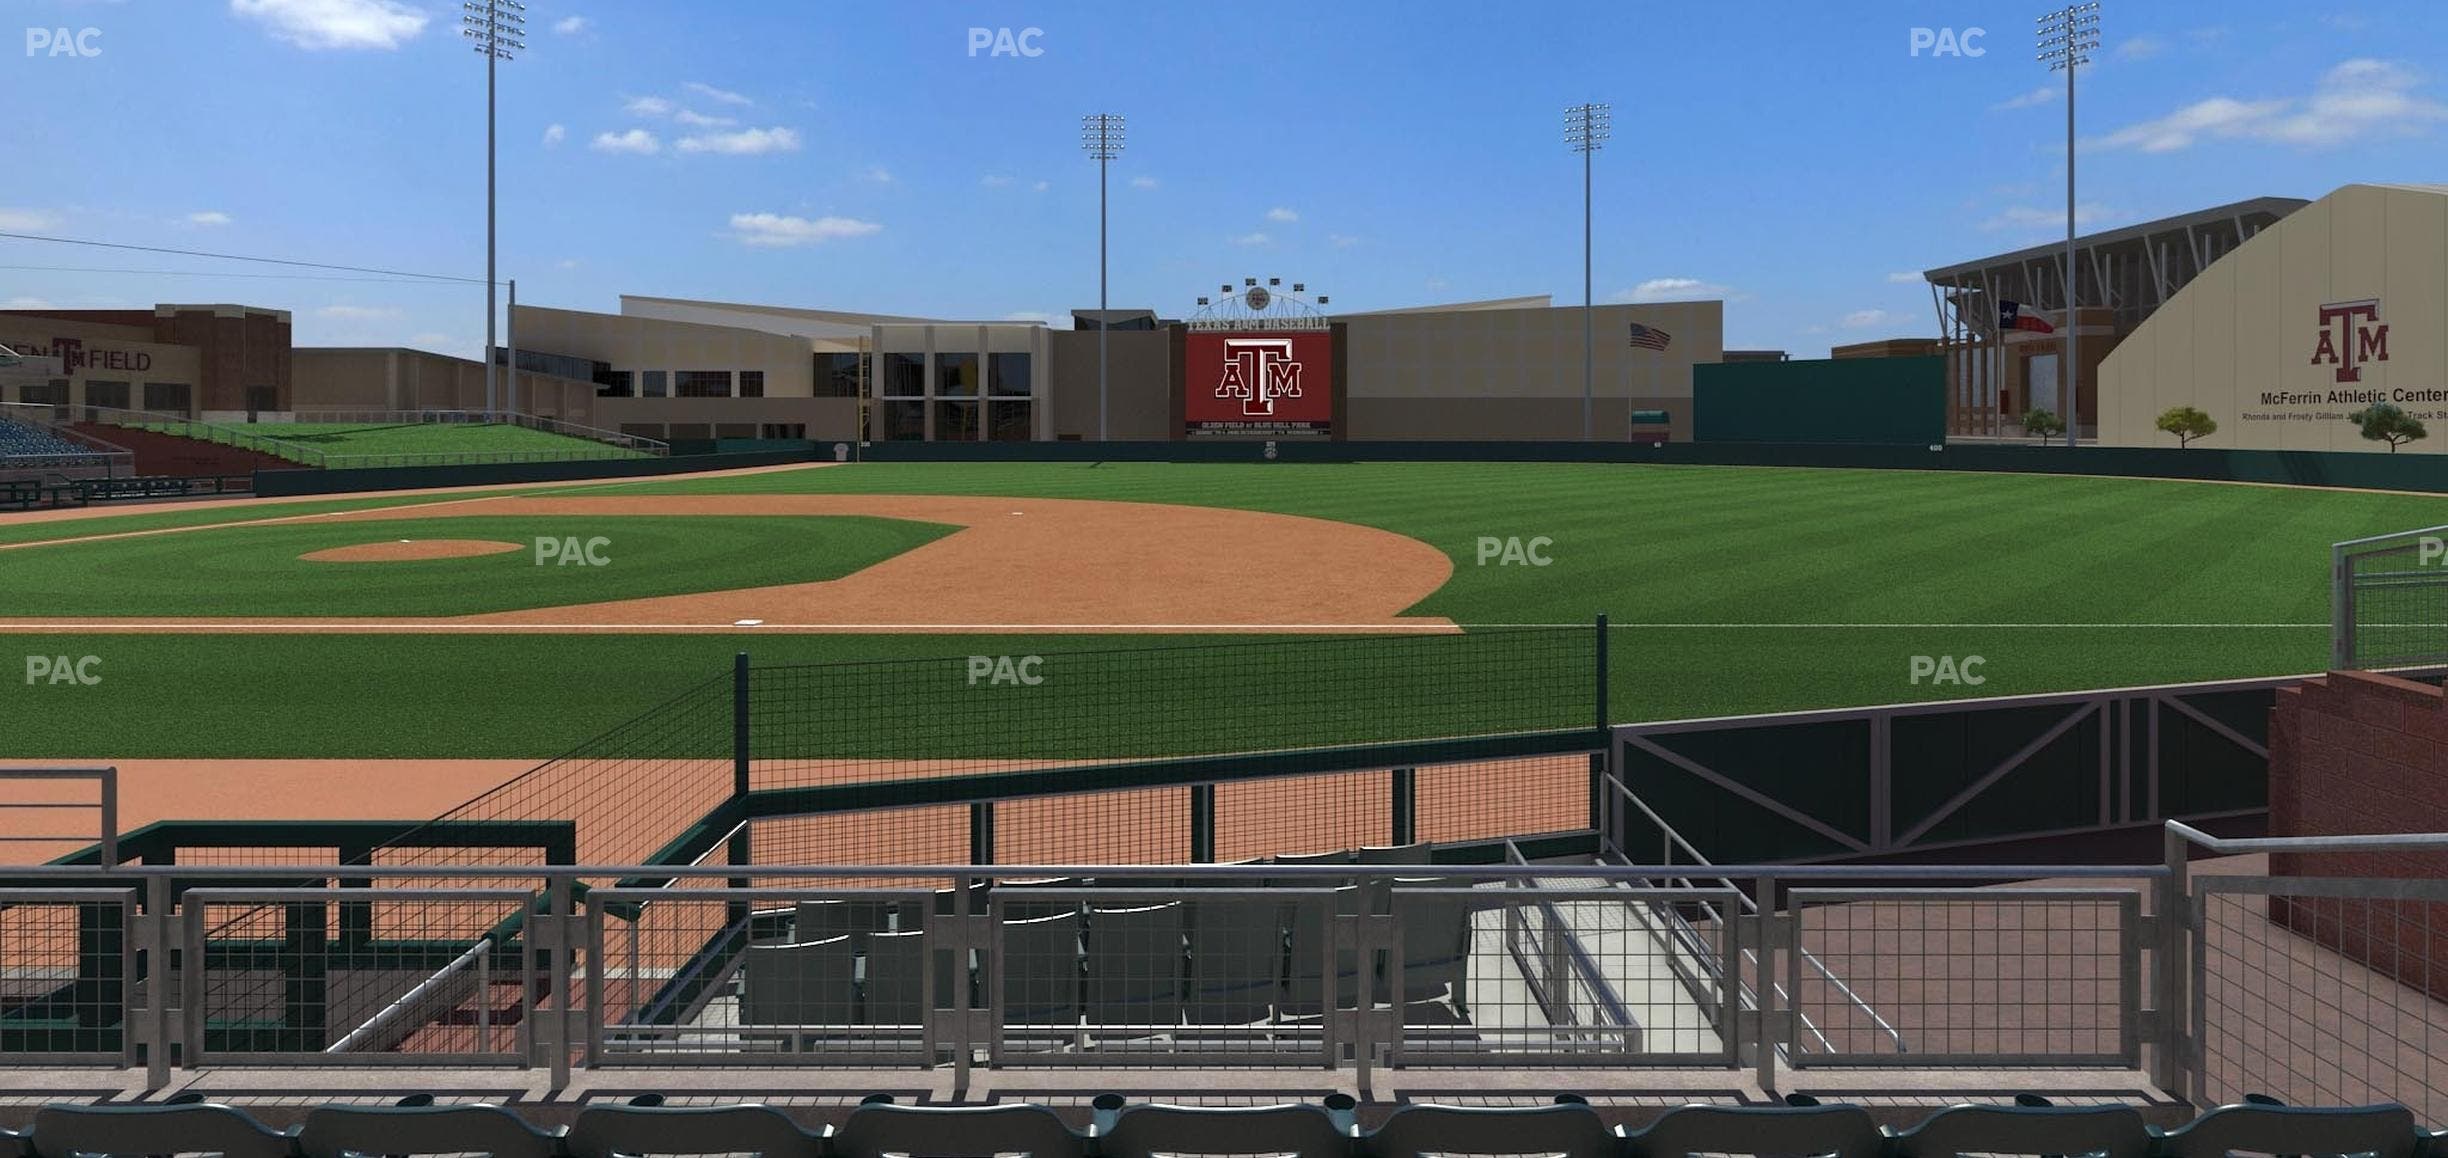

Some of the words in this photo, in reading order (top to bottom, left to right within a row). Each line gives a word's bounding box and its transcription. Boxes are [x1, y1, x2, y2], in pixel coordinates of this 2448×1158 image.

[1188, 320, 1230, 331] TEXAS
[1263, 317, 1331, 330] BASEBALL
[89, 350, 151, 371] FIELD
[2260, 391, 2322, 405] McFerrin
[2327, 389, 2387, 404] Athletic
[2392, 387, 2448, 402] Center
[2288, 412, 2313, 422] Frosty
[2408, 411, 2432, 420] Track
